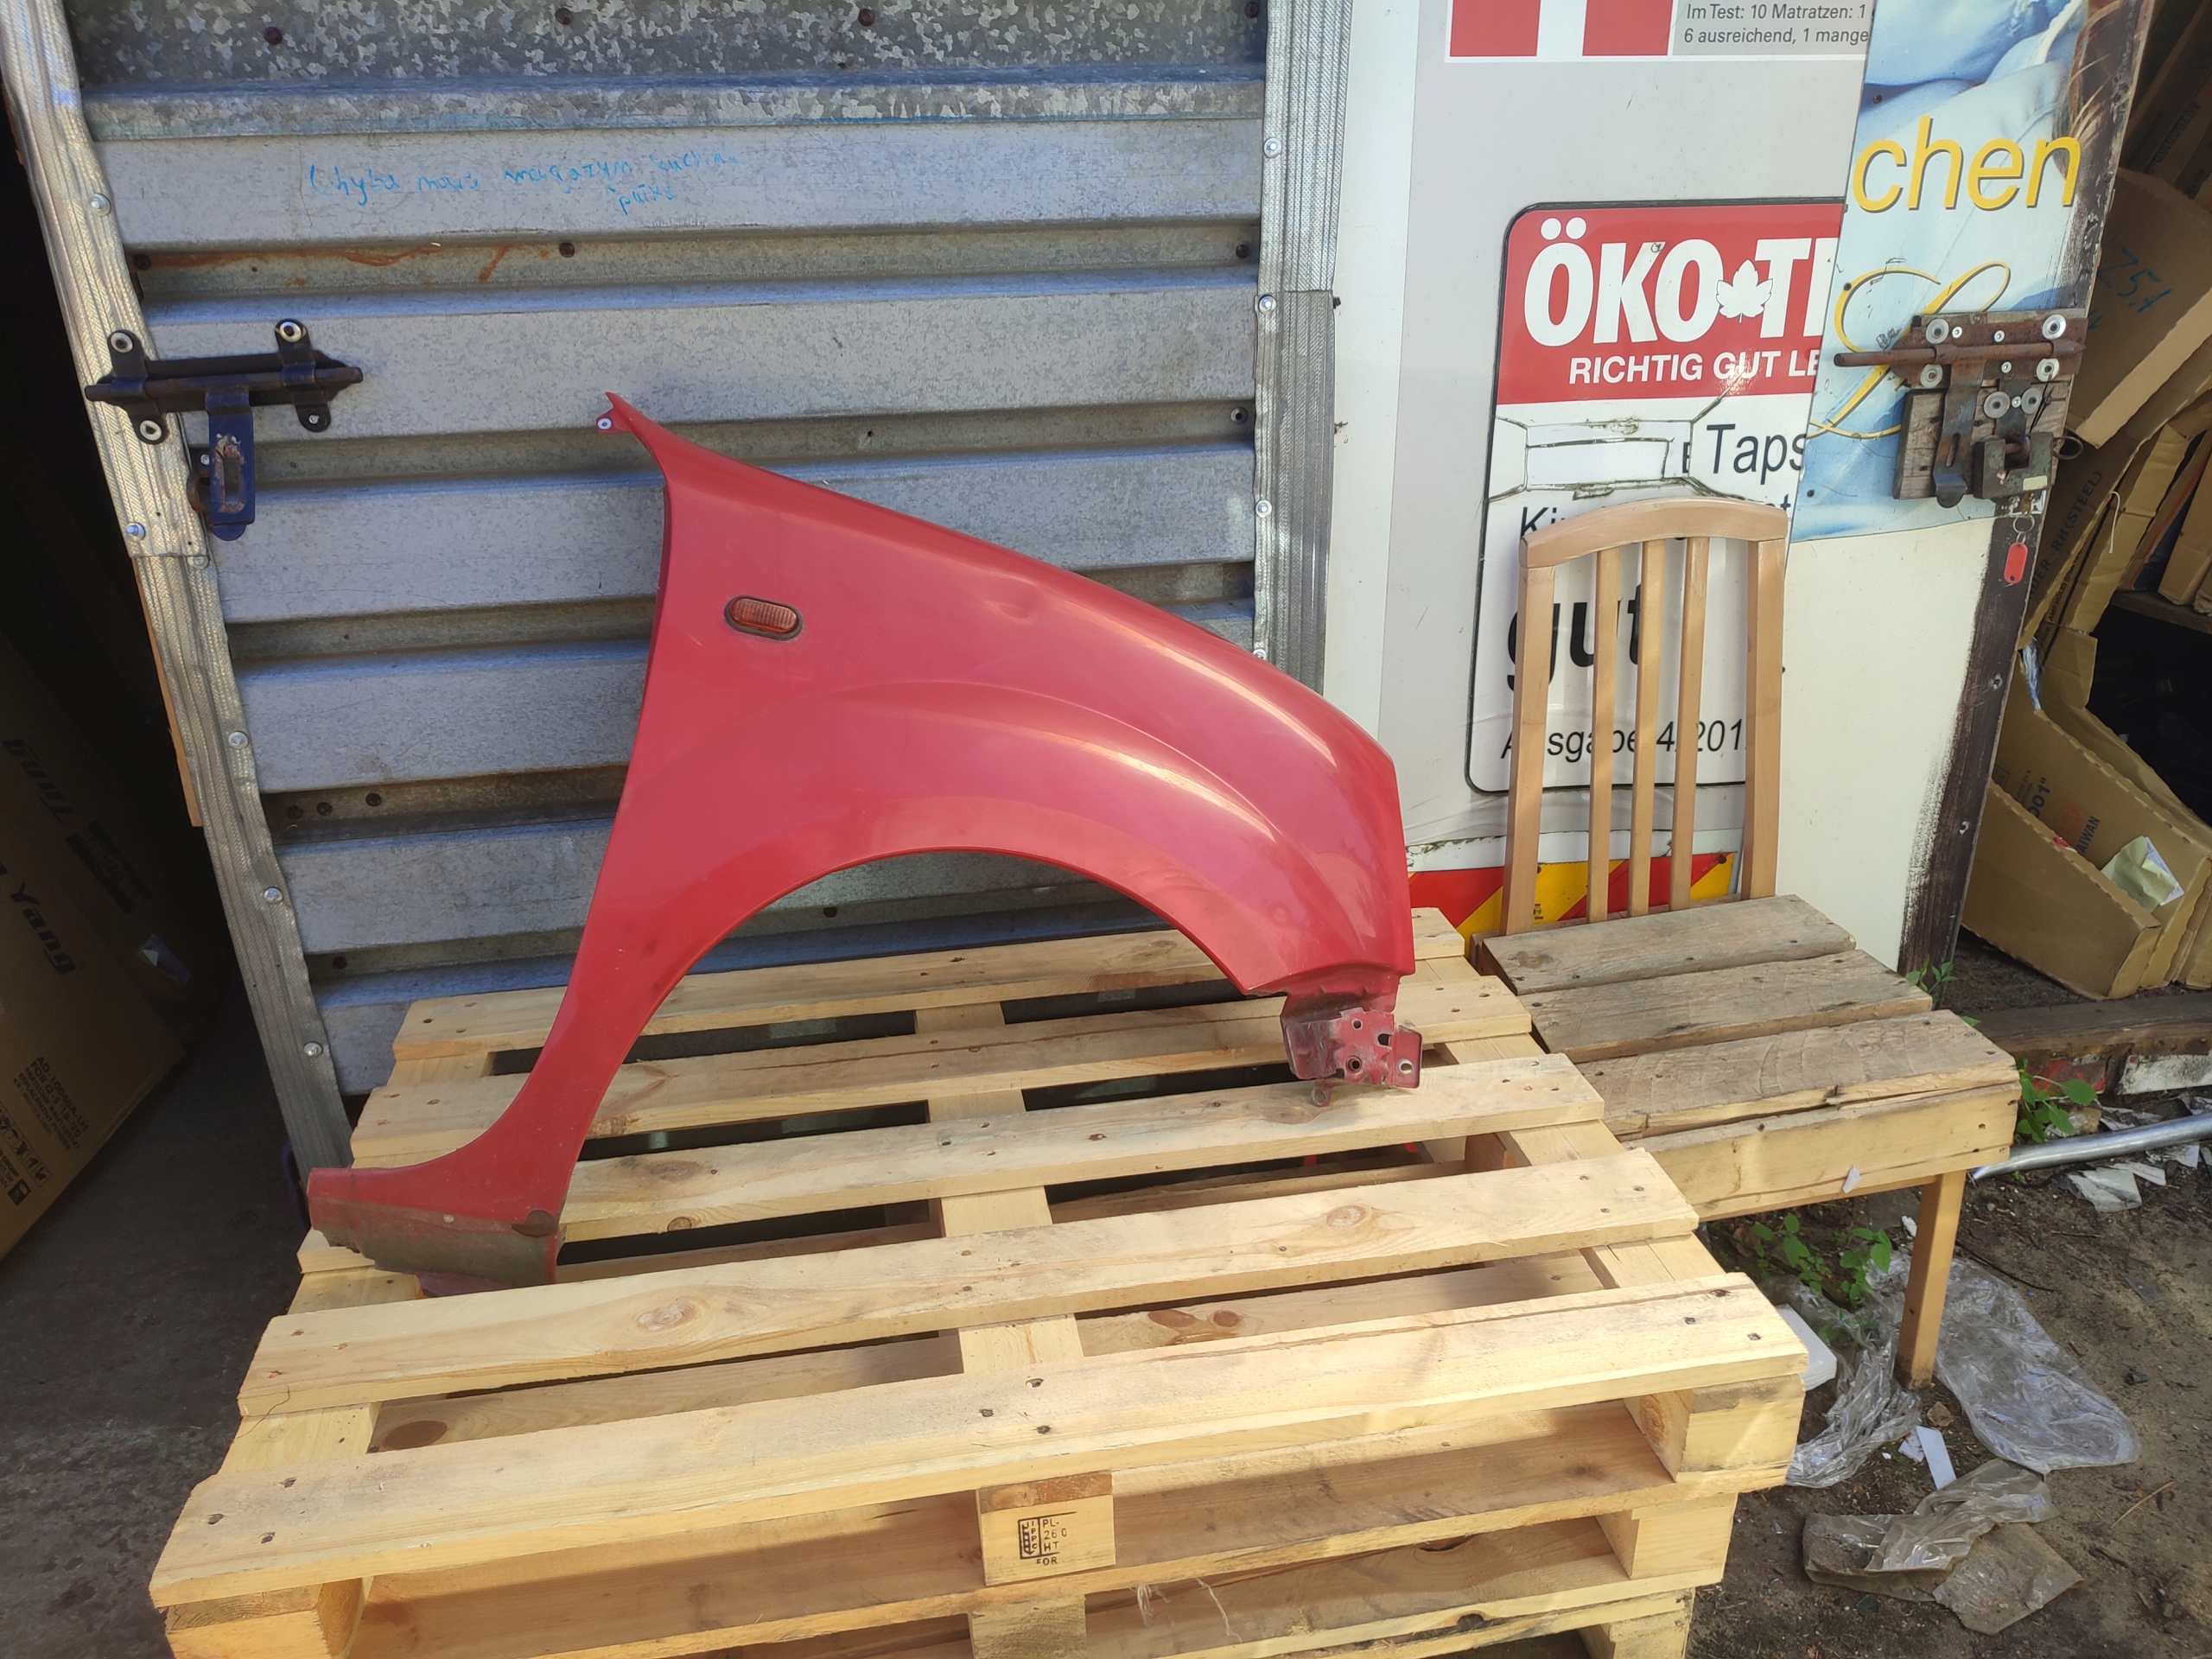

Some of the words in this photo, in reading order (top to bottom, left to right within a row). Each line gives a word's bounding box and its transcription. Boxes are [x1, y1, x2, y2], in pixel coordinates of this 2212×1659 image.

[1686, 3, 1707, 19] Im
[1709, 3, 1745, 19] Test:
[1751, 3, 1767, 19] 10
[1770, 3, 1853, 19] Matratzen:
[1859, 3, 1866, 19] 1
[1684, 28, 1694, 43] 6
[1698, 27, 1796, 45] ausreichend,
[1802, 28, 1810, 42] 1
[1815, 30, 1869, 46] mange
[1852, 114, 2082, 213] chen
[1568, 353, 1703, 385] RICHTIG
[1713, 350, 1781, 380] GUT
[2075, 815, 2101, 855] AIWAN
[10, 881, 77, 976] Yang
[1043, 1541, 1060, 1553] HT
